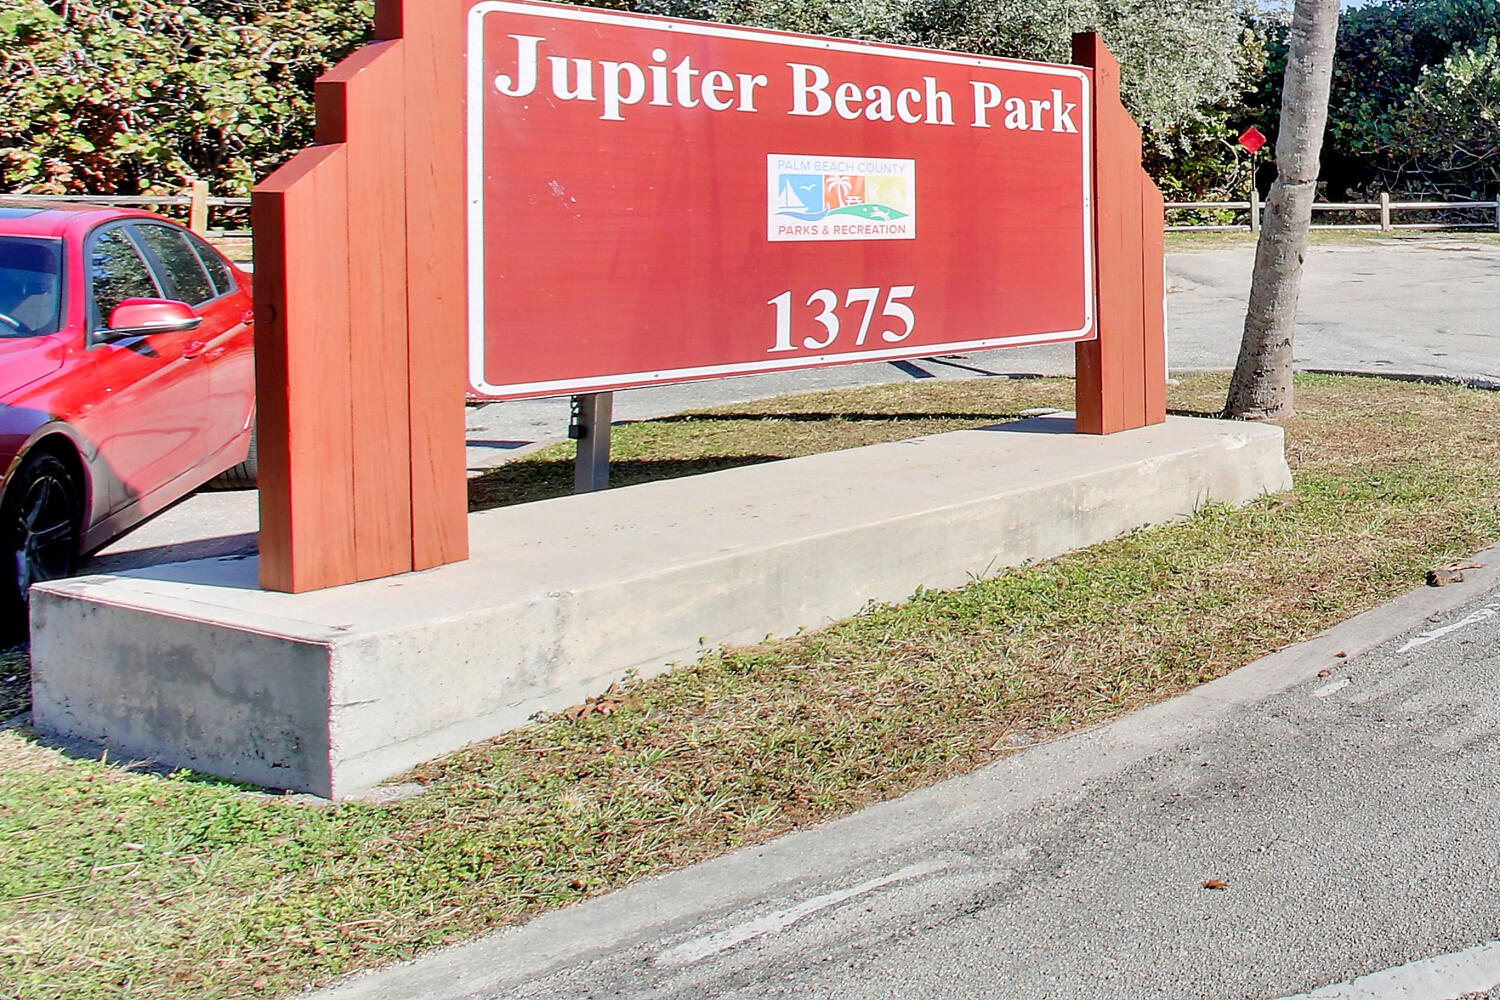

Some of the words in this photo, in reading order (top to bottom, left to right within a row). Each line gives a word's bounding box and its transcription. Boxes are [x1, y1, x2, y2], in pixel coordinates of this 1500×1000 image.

[494, 33, 769, 121] Jupiter
[785, 62, 956, 126] Beach
[969, 80, 1079, 134] Park
[777, 159, 811, 171] PALM
[814, 160, 854, 172] BEACH
[857, 162, 906, 174] COUNTY
[778, 225, 818, 235] PARKS
[822, 225, 829, 235] &
[833, 224, 906, 235] RECREATION
[766, 285, 916, 353] 1375
